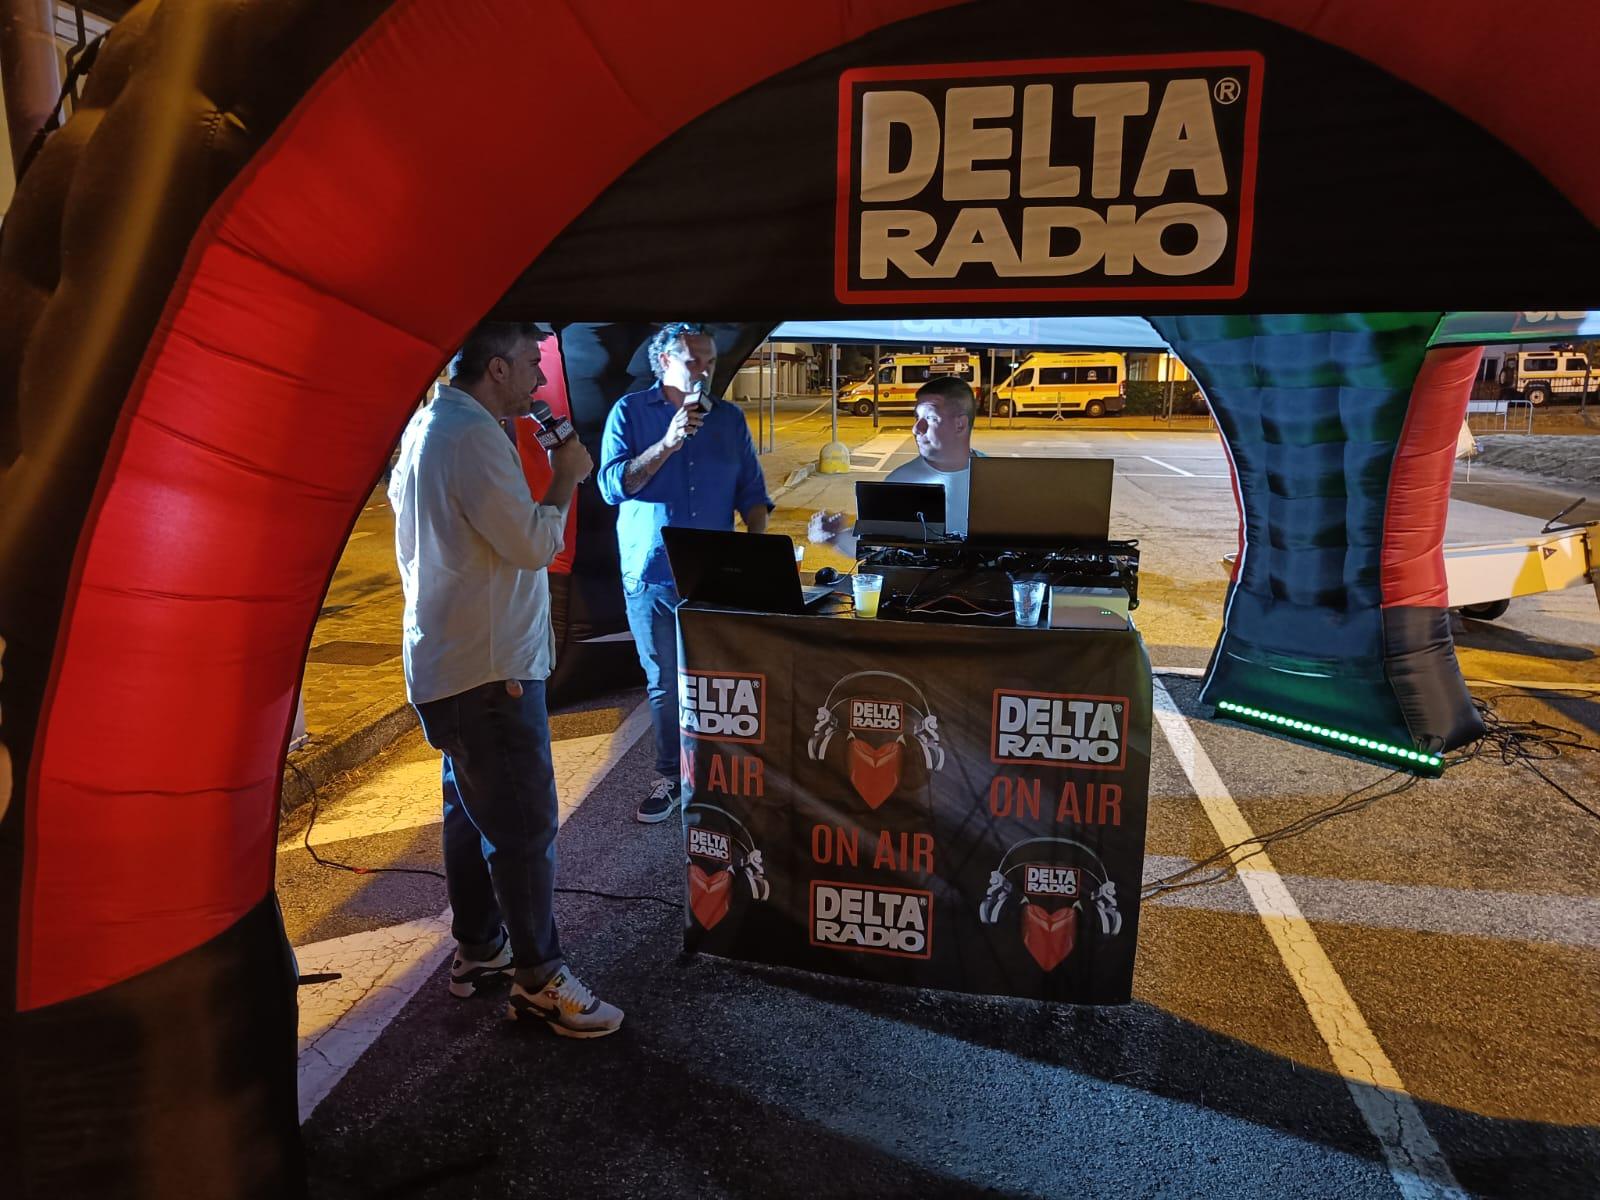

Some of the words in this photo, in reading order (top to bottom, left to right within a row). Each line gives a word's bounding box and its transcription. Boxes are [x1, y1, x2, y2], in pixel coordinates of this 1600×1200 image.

[860, 78, 1228, 202] DELTA
[859, 202, 1228, 280] RADIO
[680, 673, 759, 713] ELTA
[680, 709, 759, 737] ADIO
[853, 701, 900, 720] DELTA
[853, 717, 900, 729] RADIO
[1000, 695, 1119, 740] DELTA
[998, 733, 1119, 764] RADIO
[680, 746, 695, 788] N
[707, 753, 765, 797] AIR
[990, 775, 1041, 821] ON
[1056, 781, 1122, 826] AIR
[690, 829, 729, 852] DELTA
[690, 843, 729, 860] RADIO
[811, 824, 859, 867] ON
[873, 830, 935, 875] AIR
[1027, 867, 1077, 886] DELTA
[1027, 882, 1077, 895] RADIO
[816, 886, 926, 931] DELTA
[816, 920, 925, 952] RADIO
